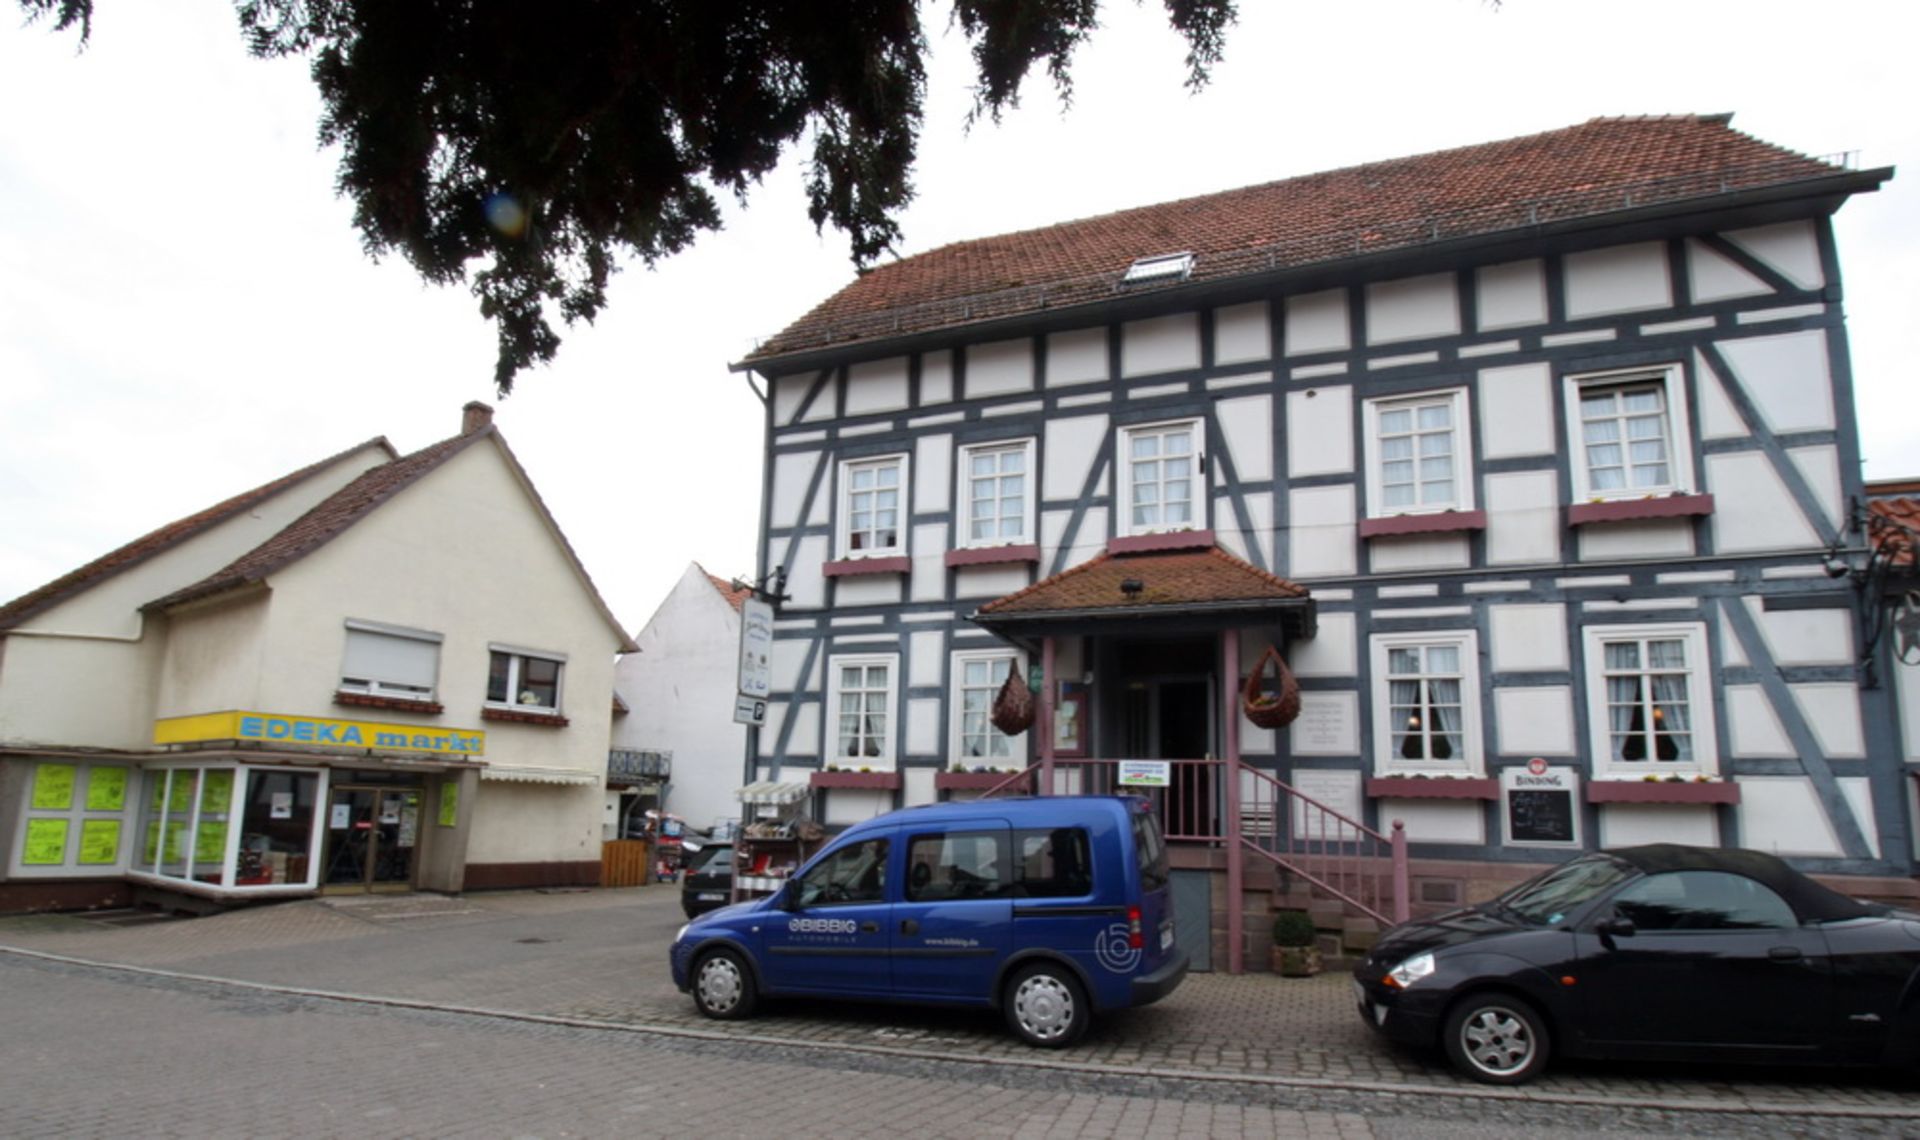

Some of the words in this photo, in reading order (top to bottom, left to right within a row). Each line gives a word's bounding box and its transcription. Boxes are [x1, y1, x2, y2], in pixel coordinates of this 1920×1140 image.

[239, 716, 363, 744] EDEKA
[375, 732, 481, 752] markt
[1515, 775, 1562, 786] BINDING
[789, 935, 857, 943] AUTOMOBILE
[924, 938, 979, 947] www.bibbig.de
